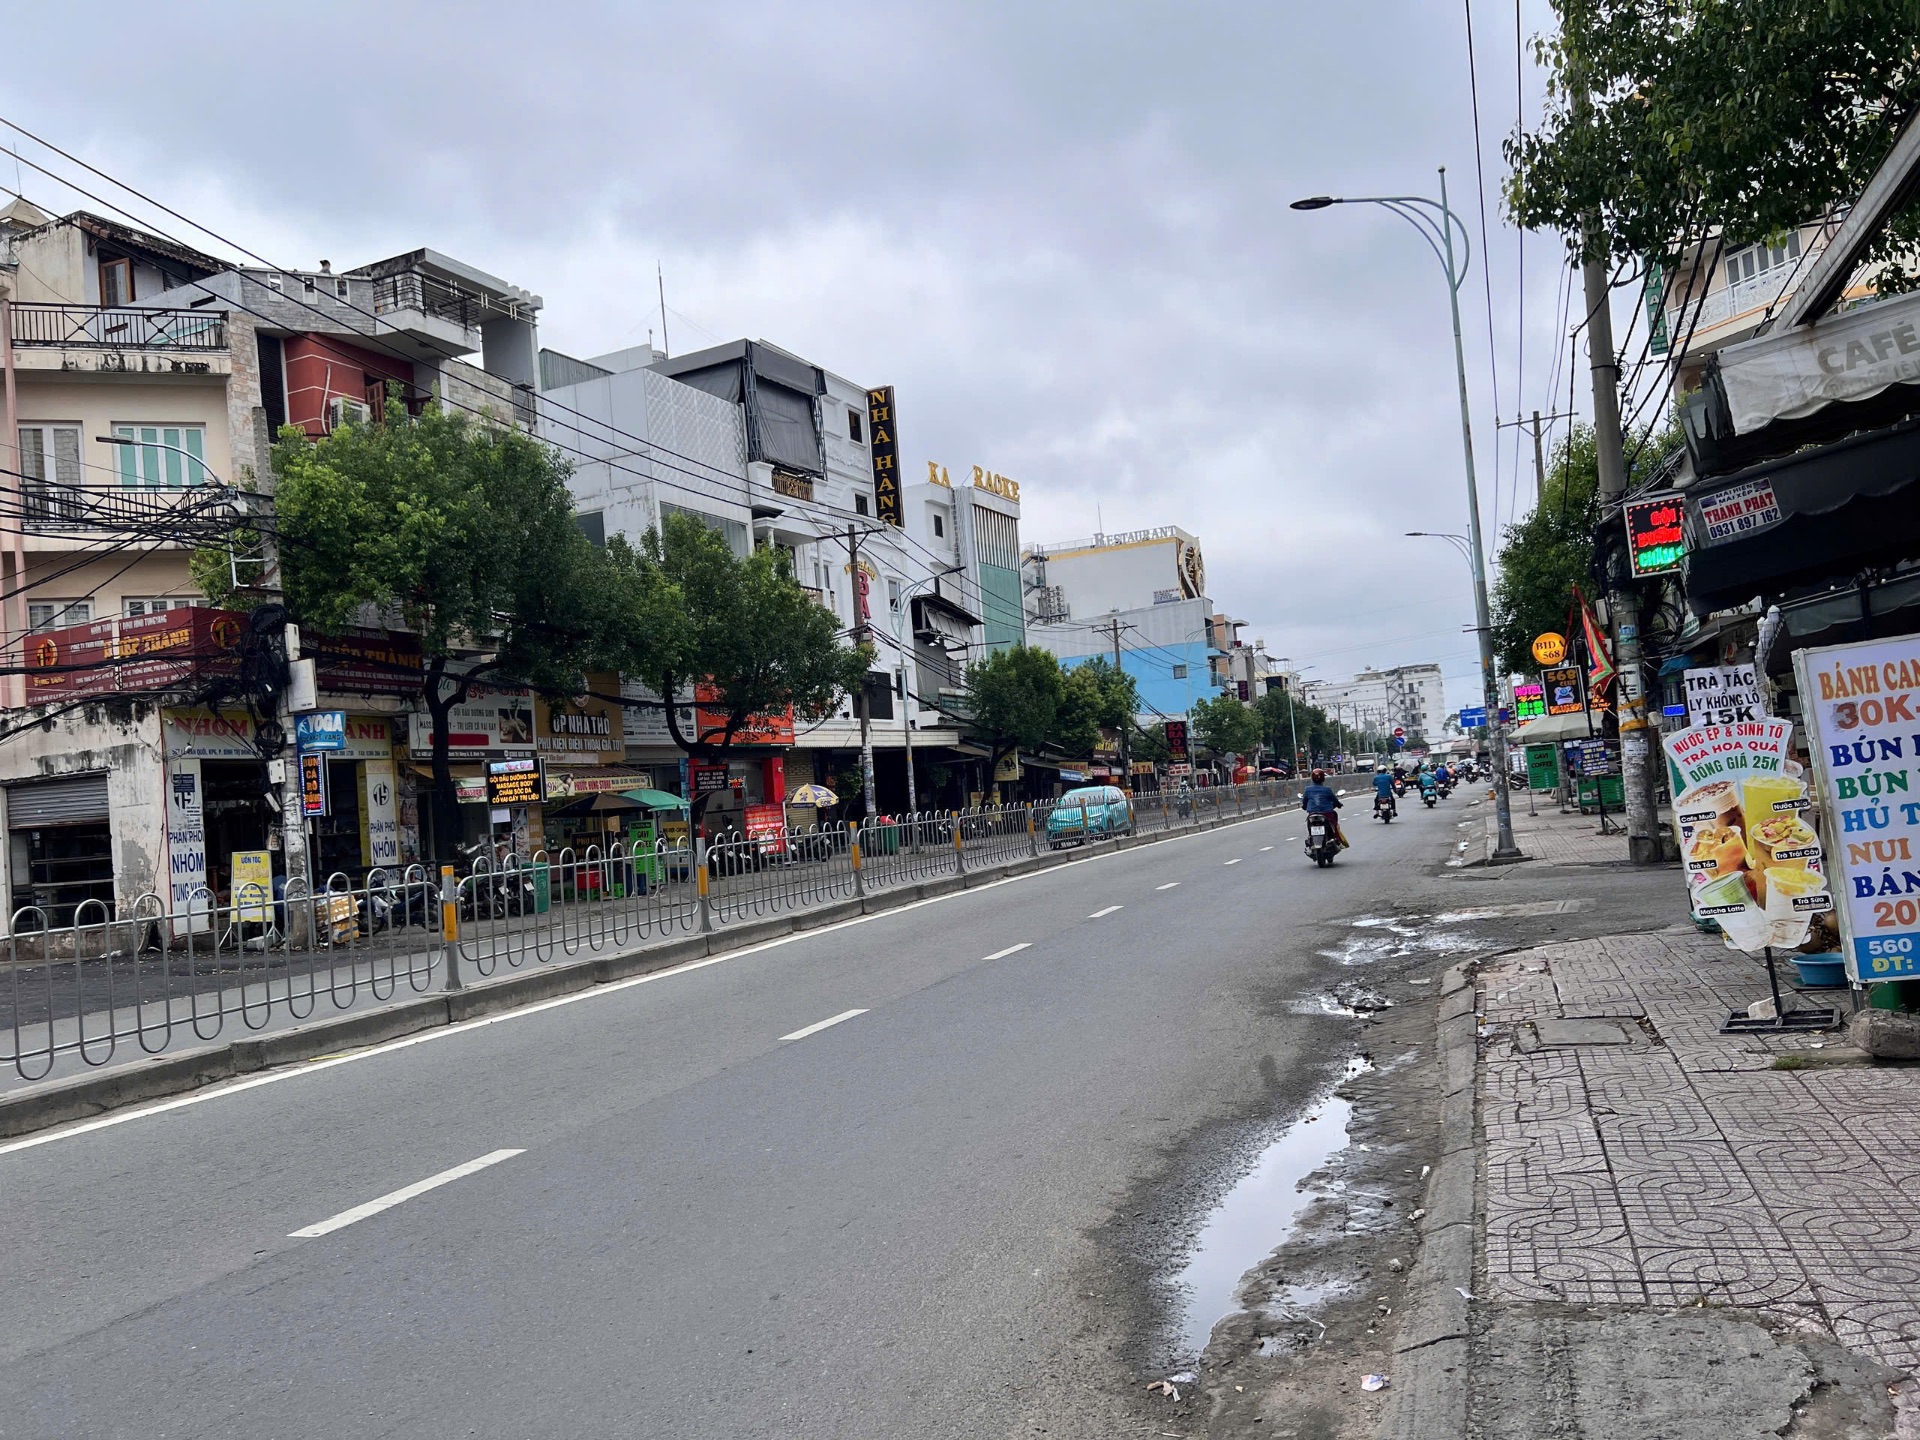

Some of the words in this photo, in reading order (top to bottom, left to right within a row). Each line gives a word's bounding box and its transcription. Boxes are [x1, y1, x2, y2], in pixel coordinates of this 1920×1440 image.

[1817, 320, 1920, 375] CAFÉ
[870, 389, 892, 445] NHÀ
[874, 454, 896, 525] HÀNG
[928, 460, 951, 488] KA
[973, 465, 1020, 501] RAOKE
[1745, 491, 1774, 514] PHÁT
[1710, 520, 1735, 539] 0931
[1738, 514, 1757, 532] 897
[1760, 508, 1780, 524] 162
[1543, 650, 1560, 660] 568
[1547, 669, 1576, 682] 568
[1686, 672, 1718, 691] TRÀ
[1724, 668, 1754, 687] TẮC
[1818, 662, 1880, 700] BÁNH
[1515, 685, 1543, 696] HOTEL
[1689, 698, 1702, 712] LY
[1706, 689, 1743, 709] KHỔNG
[307, 713, 343, 734] YOGA
[568, 710, 590, 734] NHÀ
[1702, 706, 1755, 726] 15K
[1673, 732, 1704, 754] NƯỚC
[1725, 726, 1732, 737] &
[1737, 724, 1764, 736] SINH
[1682, 748, 1710, 766] TRÀ
[1712, 742, 1743, 754] HOA
[1748, 740, 1778, 753] QUẢ
[1727, 752, 1747, 769] GIÁ
[1752, 755, 1779, 772] 25K
[1830, 735, 1902, 767] BÚN
[1531, 760, 1552, 768] COFFEE
[496, 781, 519, 789] MASSAGE
[1836, 768, 1908, 800] BÚN
[1841, 797, 1890, 832] HỦ
[372, 836, 397, 858] NHÔM
[1847, 838, 1913, 866] NUI
[172, 849, 204, 874] NHÔM
[1690, 862, 1701, 870] Trà
[172, 884, 188, 902] TUNG
[1700, 906, 1726, 914] Matcha
[1869, 937, 1913, 955] 560
[1872, 956, 1913, 973] ĐT:
